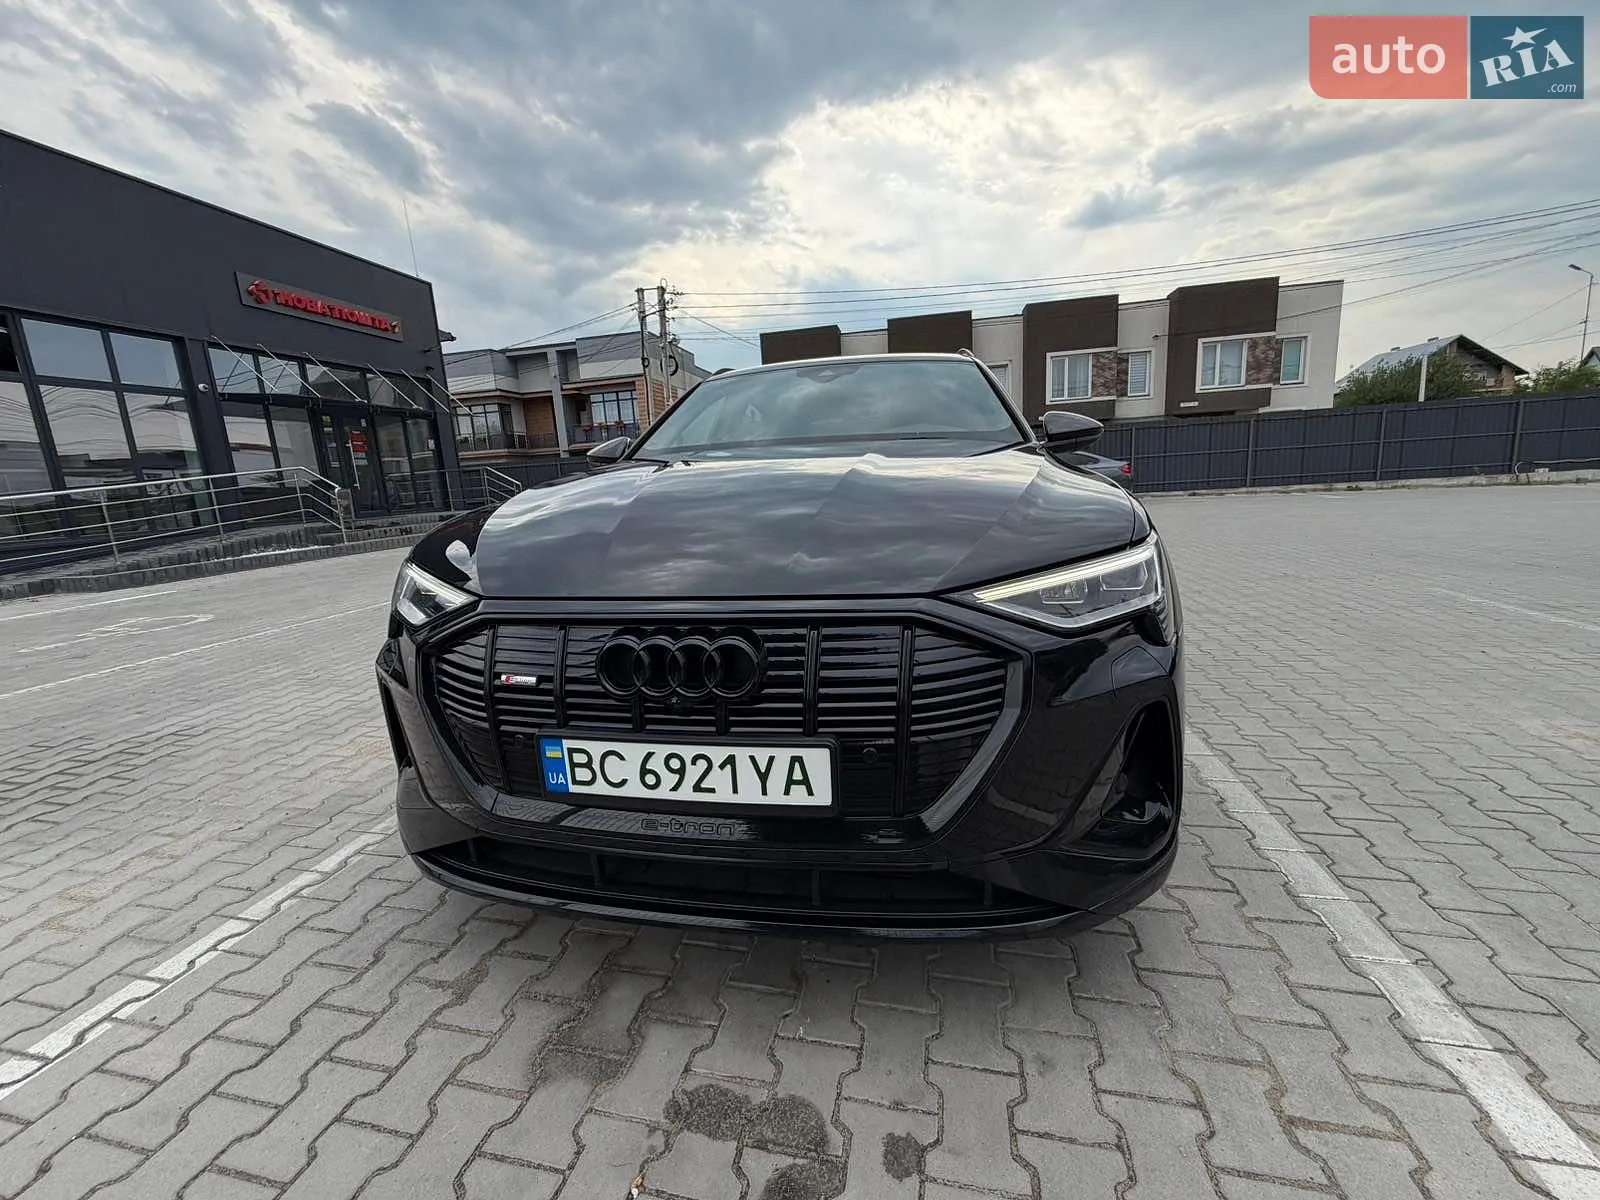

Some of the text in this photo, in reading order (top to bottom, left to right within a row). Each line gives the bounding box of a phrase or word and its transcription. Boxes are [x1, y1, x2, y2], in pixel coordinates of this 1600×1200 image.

[549, 771, 567, 785] UA
[567, 747, 815, 797] BC 6921 YA
[641, 817, 735, 836] e-tron
